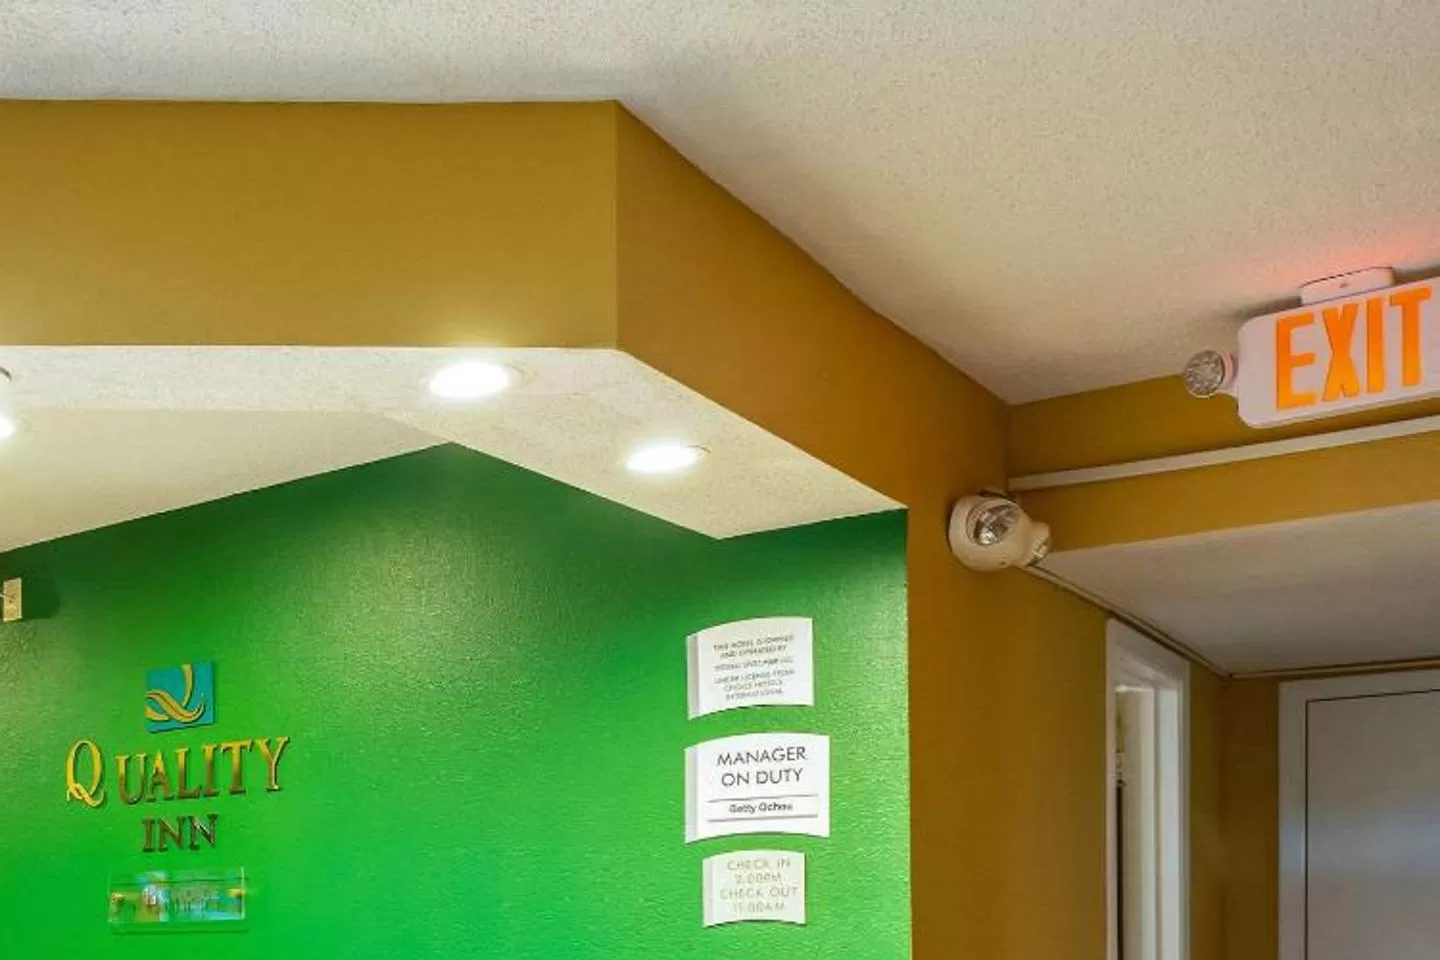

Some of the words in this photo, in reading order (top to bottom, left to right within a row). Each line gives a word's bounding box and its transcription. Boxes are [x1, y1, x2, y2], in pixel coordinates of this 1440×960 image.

[1275, 286, 1433, 412] EXIT
[717, 746, 807, 767] MANAGER
[66, 736, 290, 808] QUALITY
[721, 771, 750, 787] ON
[756, 768, 803, 784] DUTY
[142, 814, 218, 852] INN
[727, 859, 769, 870] CHECK
[777, 857, 792, 868] IN
[720, 887, 764, 900] CHECK
[769, 886, 798, 898] OUT
